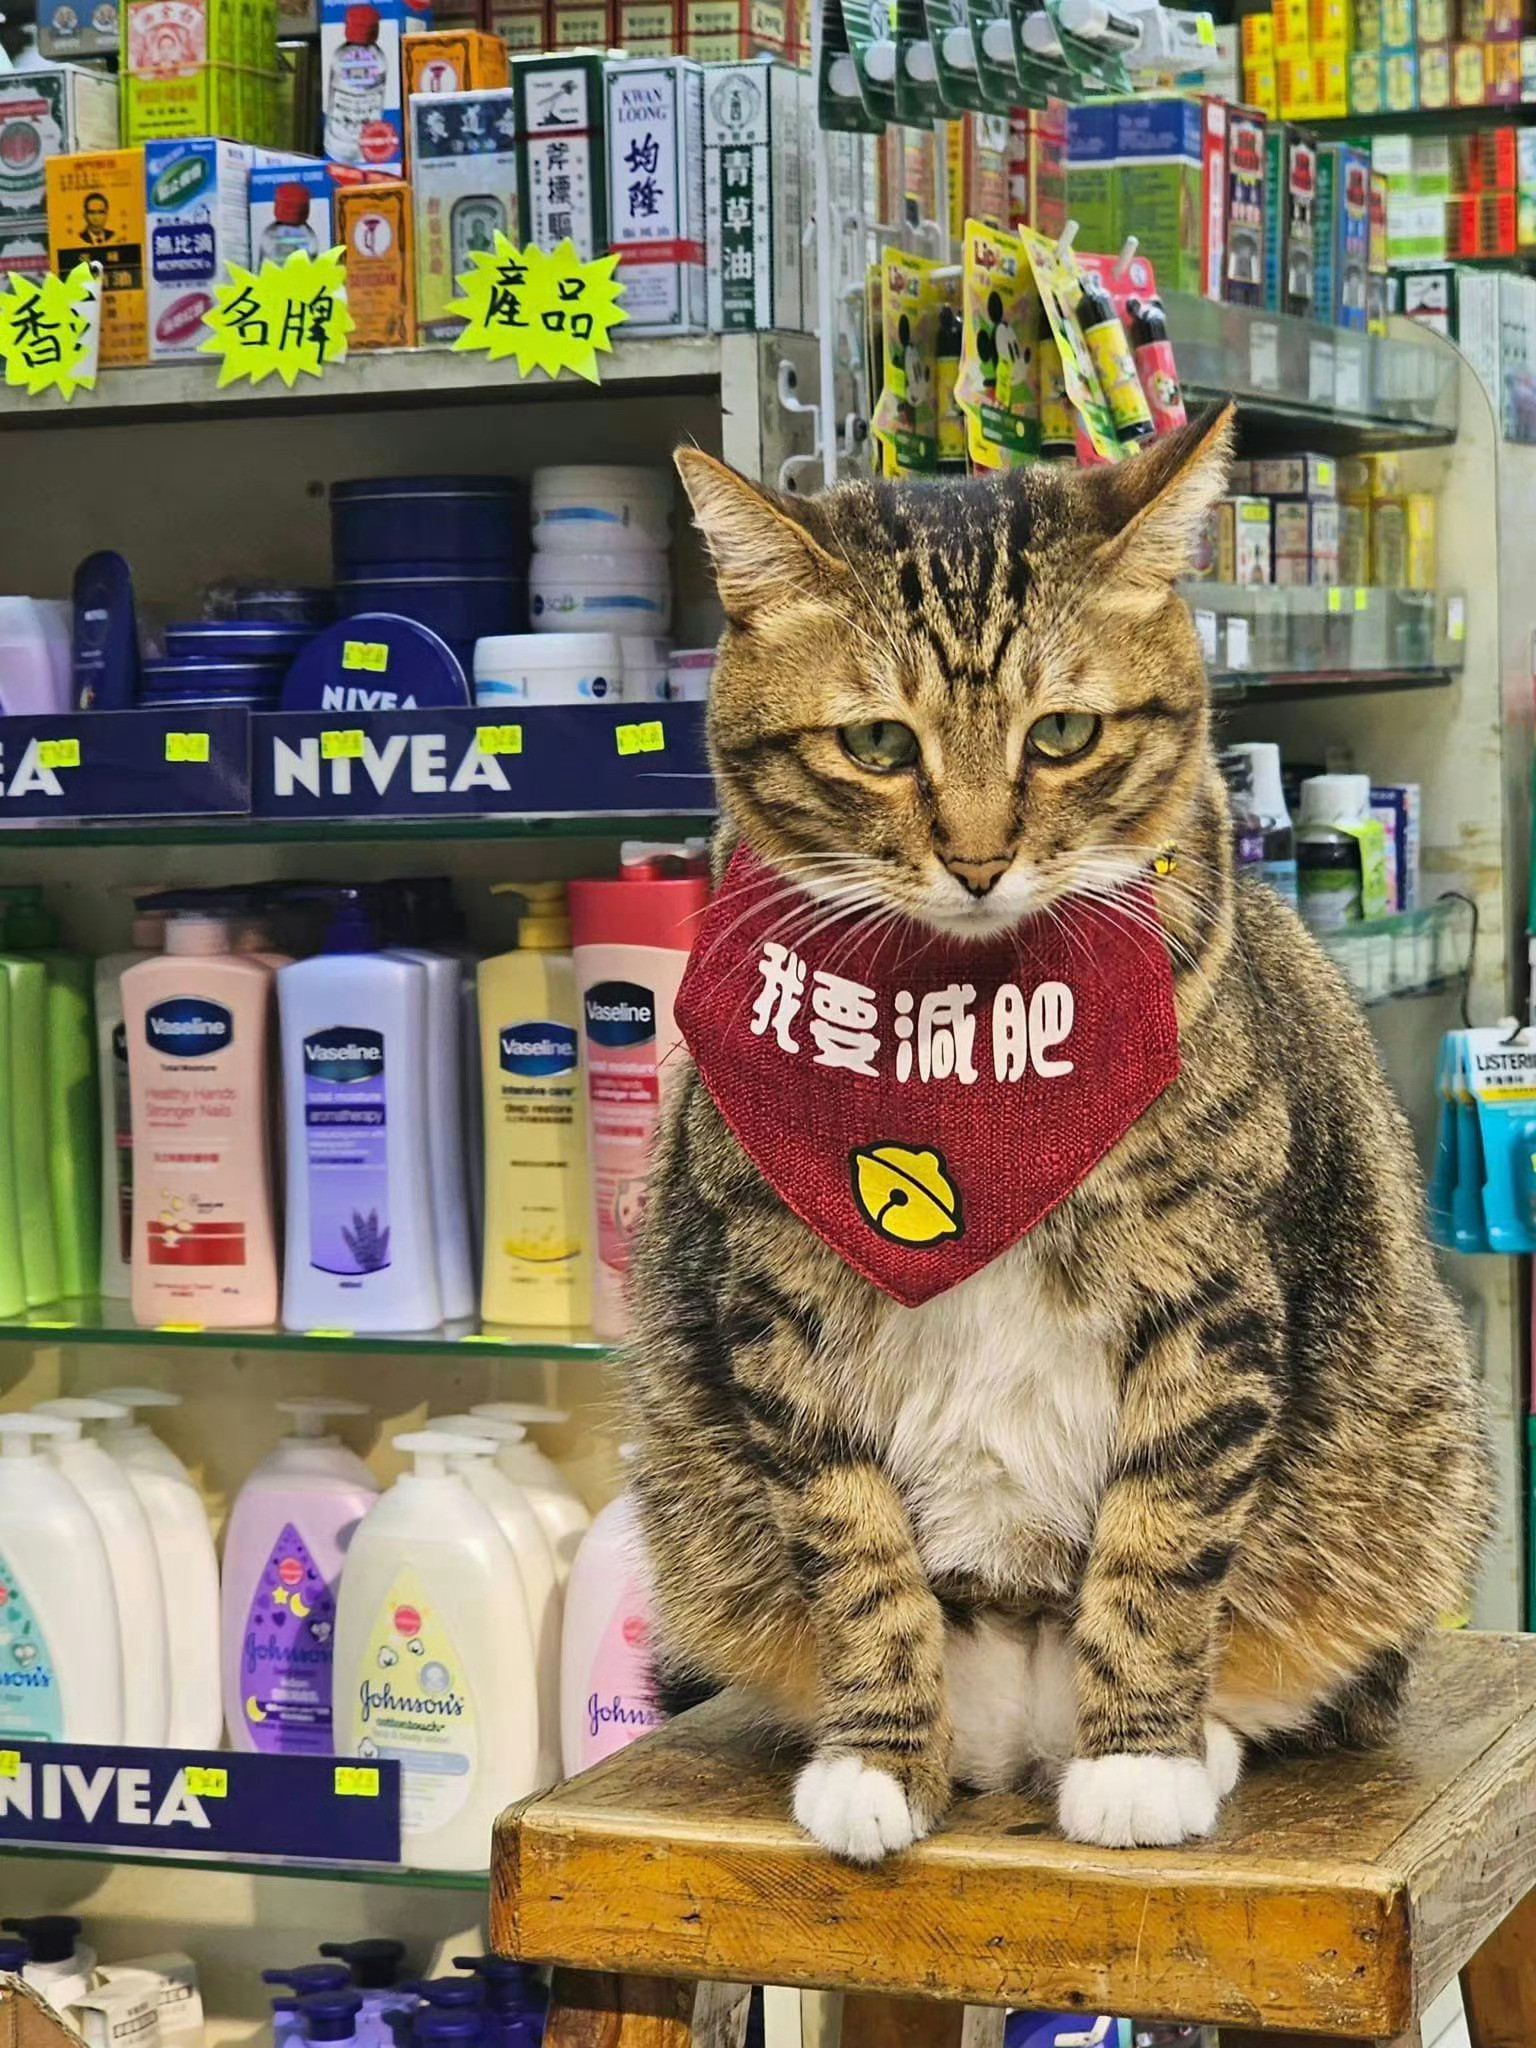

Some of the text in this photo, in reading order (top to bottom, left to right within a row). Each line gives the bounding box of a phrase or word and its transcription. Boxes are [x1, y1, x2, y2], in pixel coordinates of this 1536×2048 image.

[618, 106, 668, 123] LOONG
[622, 89, 663, 105] KWAN
[624, 133, 664, 219] 均隆
[722, 151, 755, 281] 青草油
[484, 259, 595, 341] 產品
[224, 286, 334, 365] 名牌
[321, 683, 418, 711] NIVEA
[0, 736, 64, 798] A
[273, 733, 512, 798] NIVEA
[150, 1017, 225, 1036] Vaseline
[587, 1001, 652, 1022] Vaseline
[750, 942, 1075, 1085] 我要減肥
[502, 1039, 574, 1056] Vaseline
[194, 1087, 236, 1100] Hands
[146, 1103, 232, 1120] Stronger Nails
[310, 1109, 383, 1125] aromatherapy
[360, 1680, 464, 1722] Johnson's
[0, 1762, 212, 1829] NIVEA
